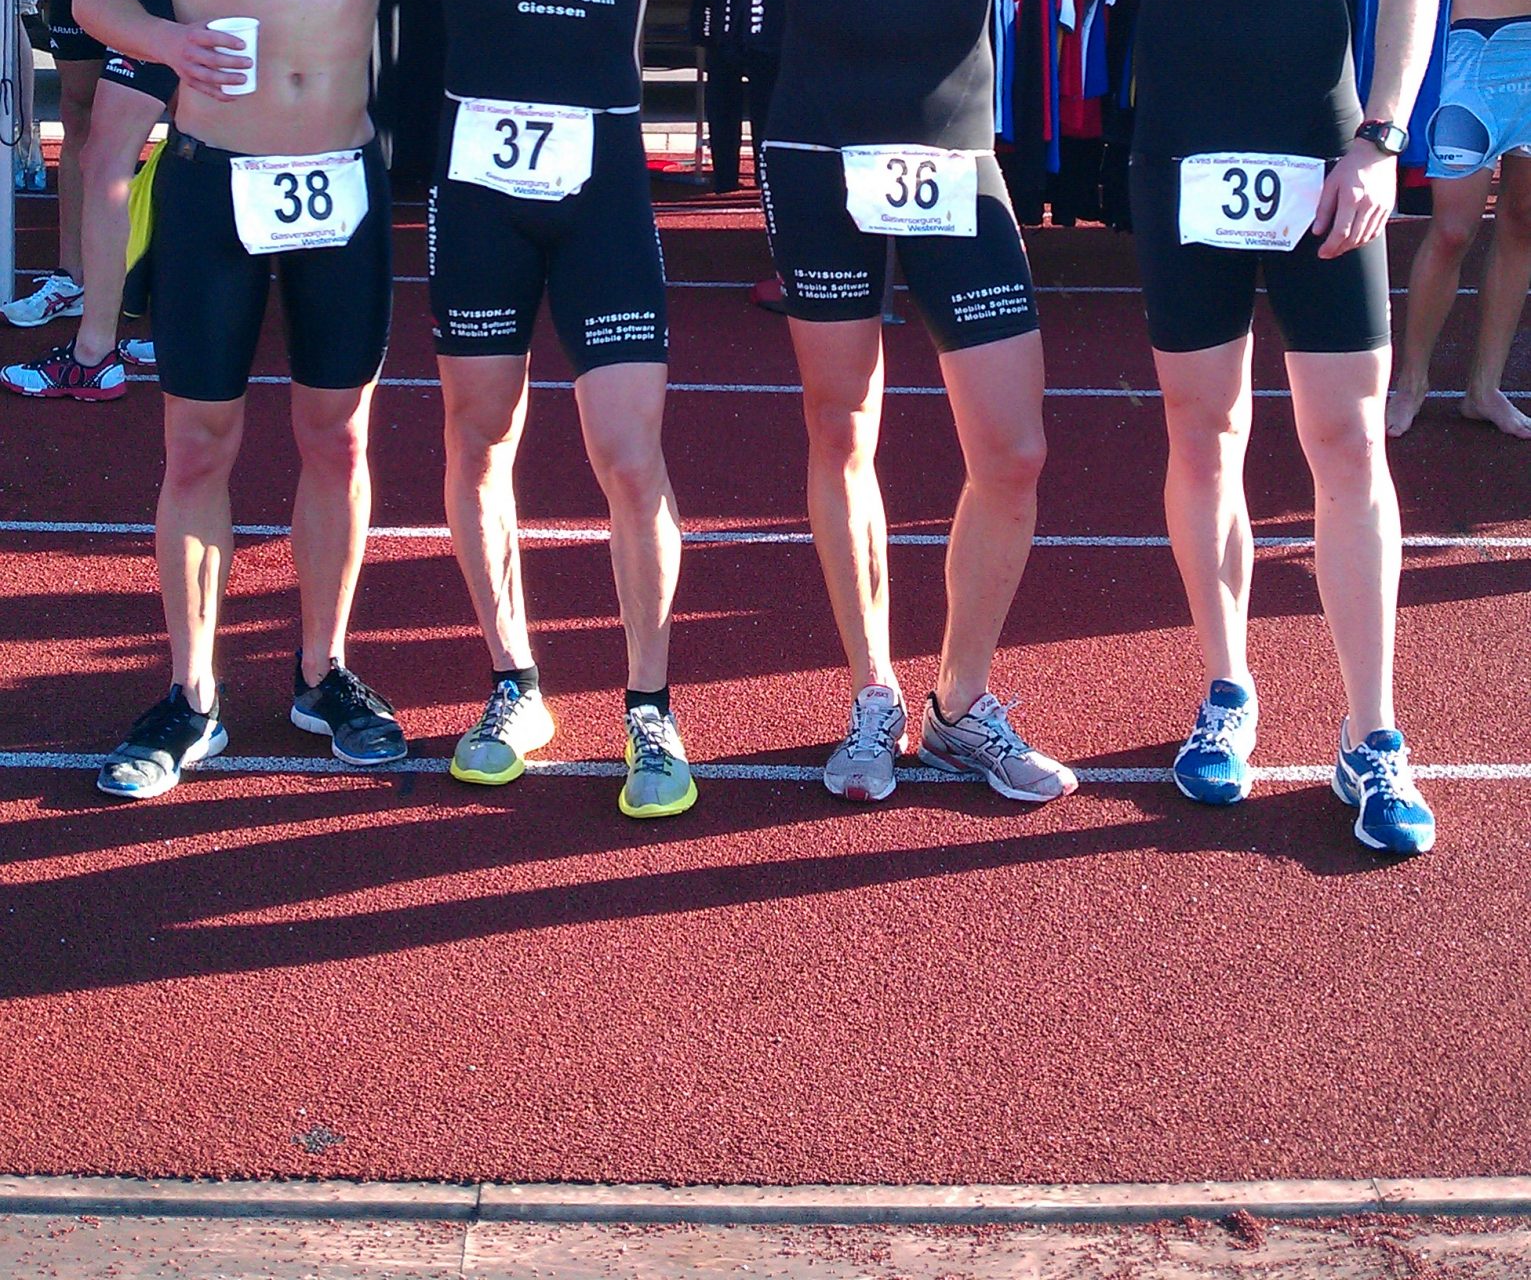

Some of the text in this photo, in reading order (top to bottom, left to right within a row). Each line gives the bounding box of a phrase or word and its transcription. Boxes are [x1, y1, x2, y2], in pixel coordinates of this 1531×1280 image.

[517, 1, 586, 18] Giessen
[492, 118, 554, 170] 37
[885, 158, 940, 210] 36
[273, 169, 334, 224] 38
[1221, 167, 1282, 222] 39
[271, 229, 336, 241] Gasversorgung
[428, 185, 439, 276] Triathlon
[907, 224, 956, 232] Westerwald
[794, 269, 868, 279] IS-VISION.de
[796, 282, 828, 291] Mobile
[831, 283, 870, 291] Software
[951, 283, 1025, 303] IS-VISION.de
[805, 291, 838, 299] Mobile
[841, 289, 870, 298] People
[448, 308, 517, 318] IS-VISION.de
[954, 297, 1027, 315] Mobile Software
[585, 311, 656, 326] IS-VISION.de
[964, 310, 997, 322] Mobile
[999, 305, 1029, 316] People
[449, 320, 517, 330] Mobile Software
[491, 327, 517, 336] People
[585, 324, 655, 338] Mobile Software
[592, 335, 622, 345] Mobile
[624, 332, 655, 341] People
